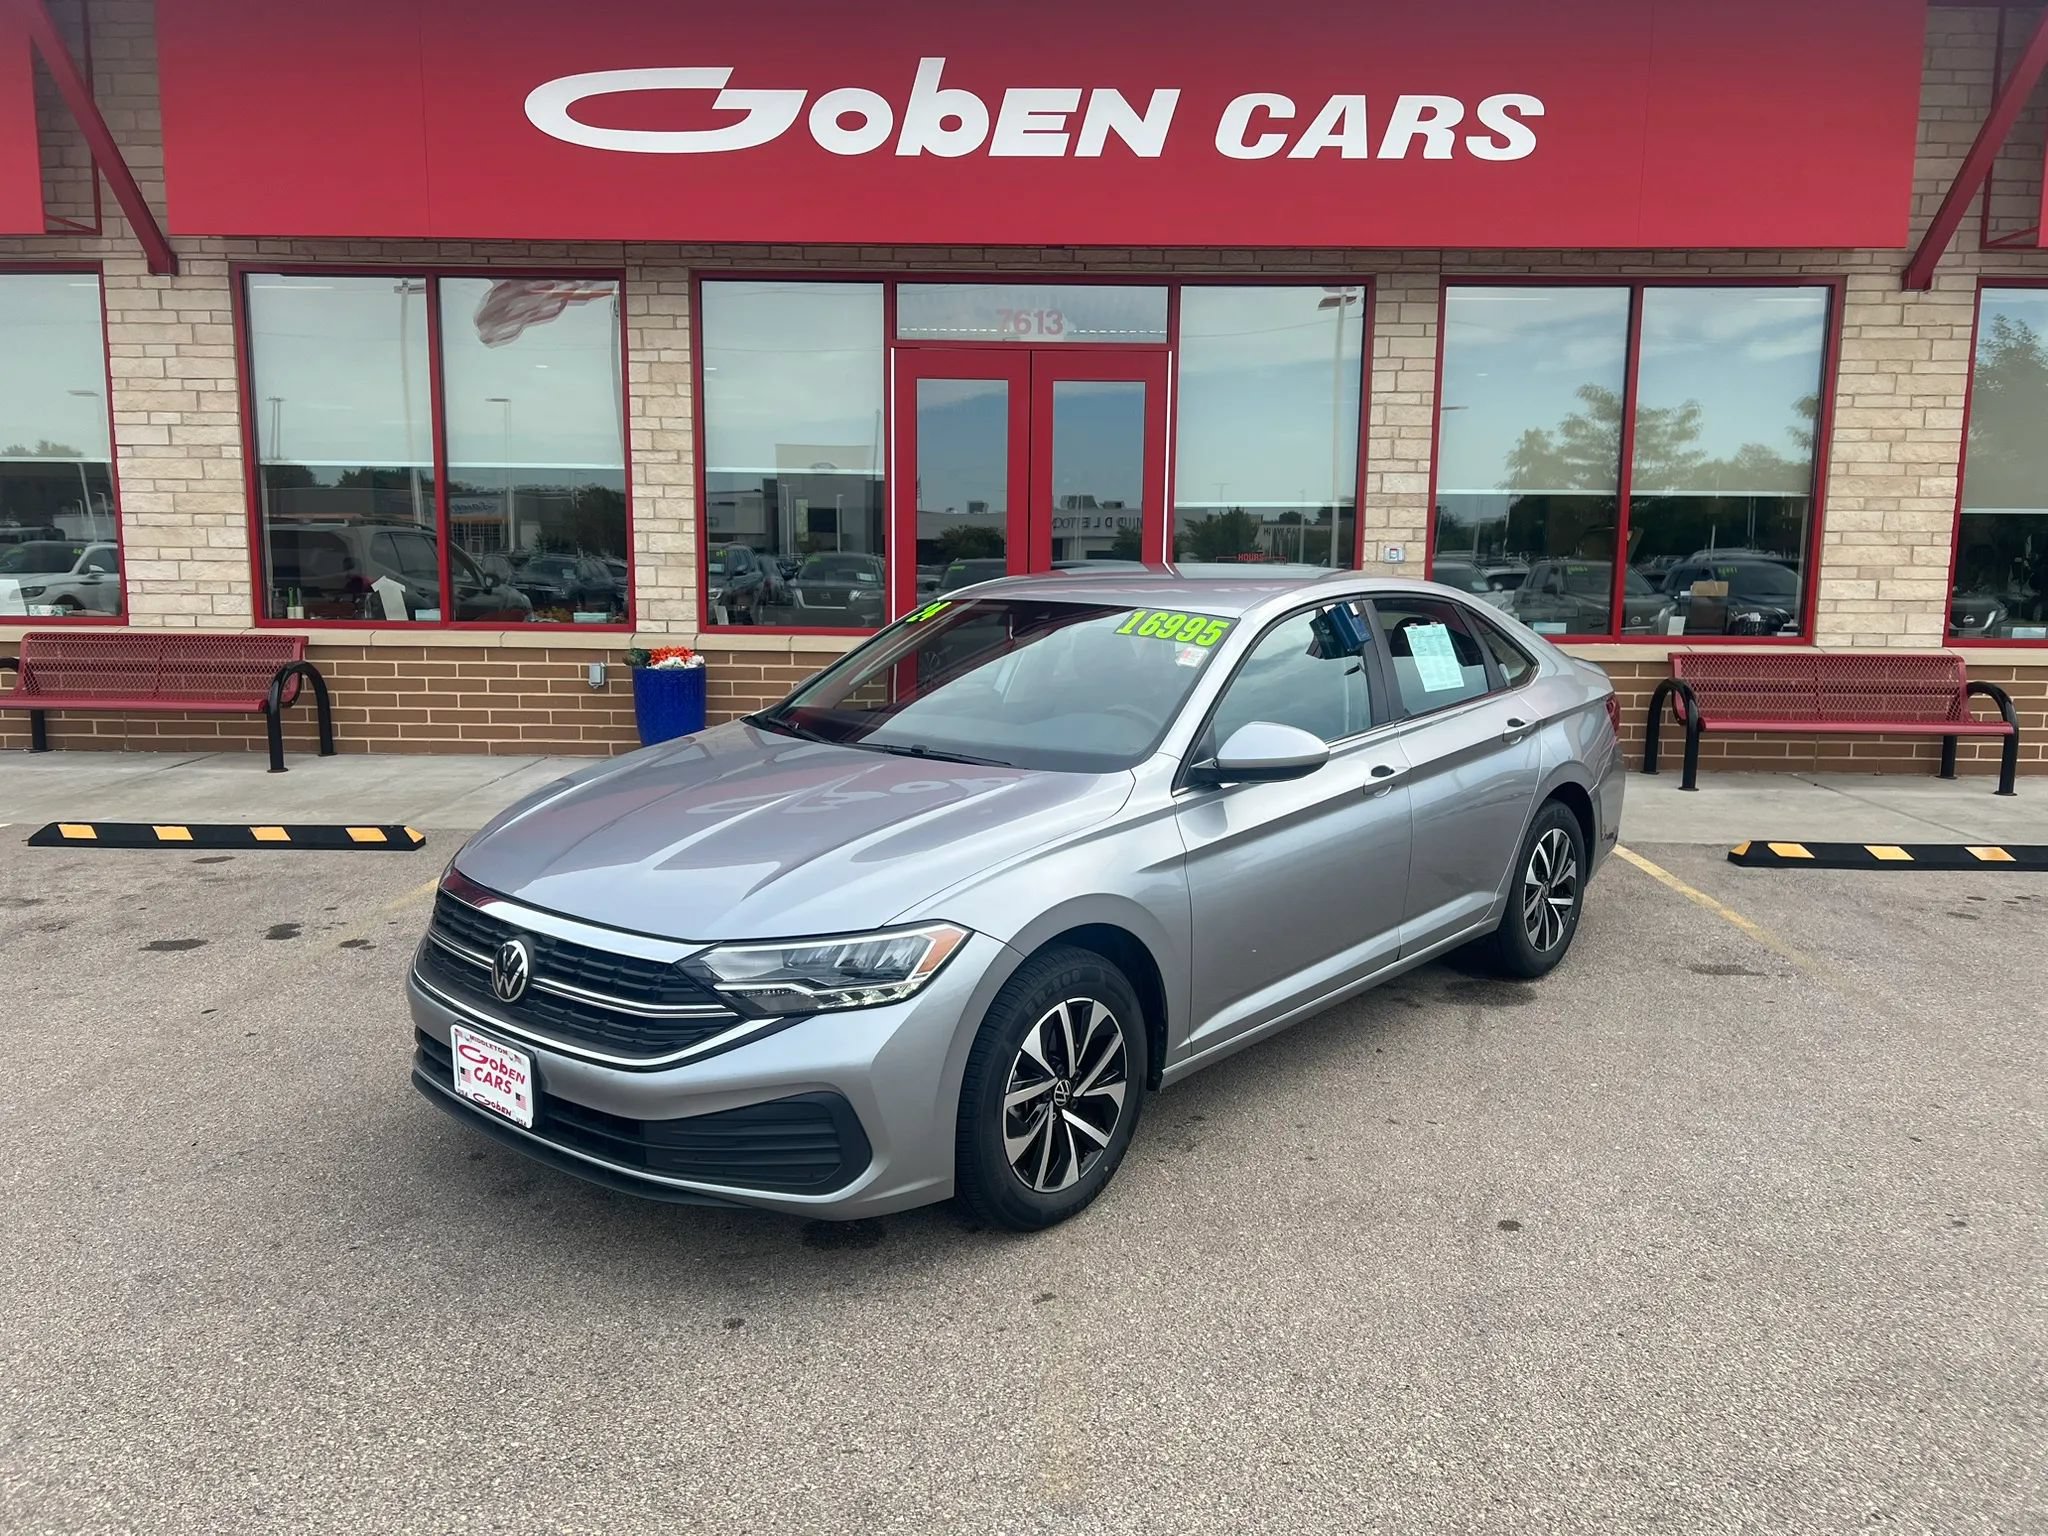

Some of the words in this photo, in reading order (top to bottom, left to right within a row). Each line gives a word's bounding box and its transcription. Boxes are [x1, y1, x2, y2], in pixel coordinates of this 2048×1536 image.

[1215, 93, 1545, 161] CARS
[996, 309, 1064, 335] 7613
[1238, 553, 1265, 561] HOURS
[1116, 610, 1230, 646] 16995
[470, 1034, 508, 1055] MIDDLETON
[474, 1067, 512, 1094] CARS
